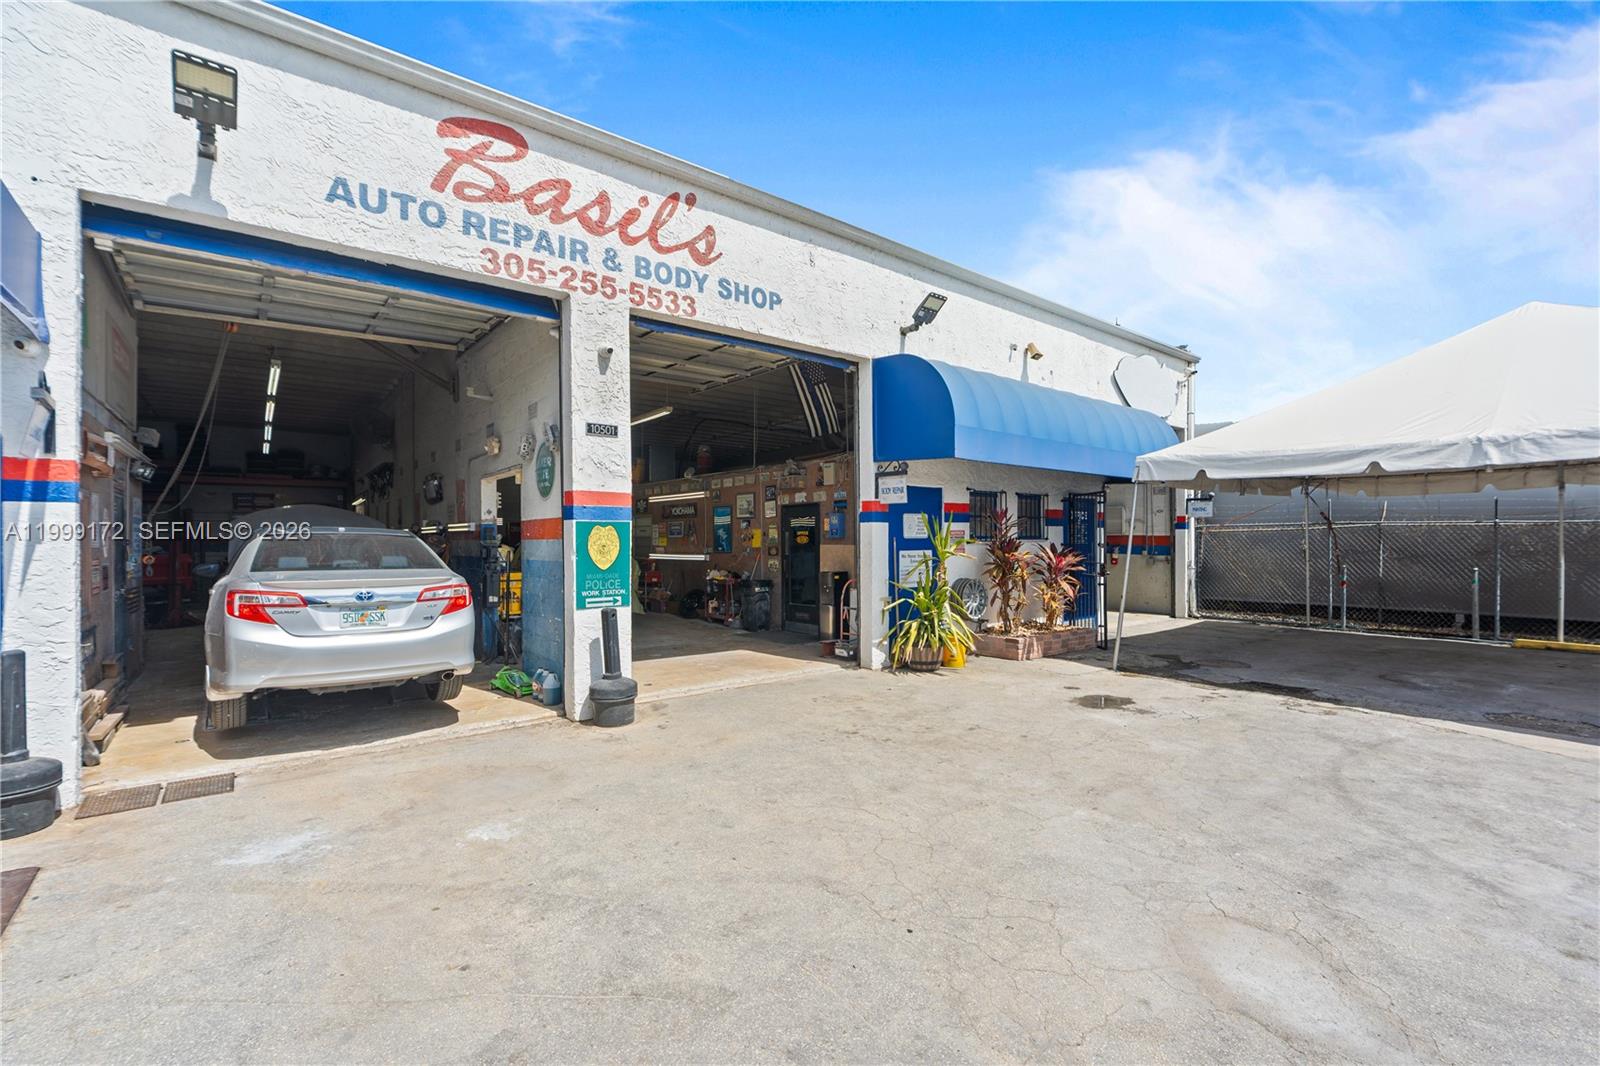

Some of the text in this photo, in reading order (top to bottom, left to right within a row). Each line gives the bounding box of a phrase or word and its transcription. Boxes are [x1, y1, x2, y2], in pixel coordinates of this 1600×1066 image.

[430, 116, 724, 267] Basil's
[325, 176, 784, 311] AUTO REPAIR & BODY SHOP
[479, 247, 698, 318] 305-255-5533
[590, 424, 615, 435] 10501
[585, 579, 621, 590] POLICE
